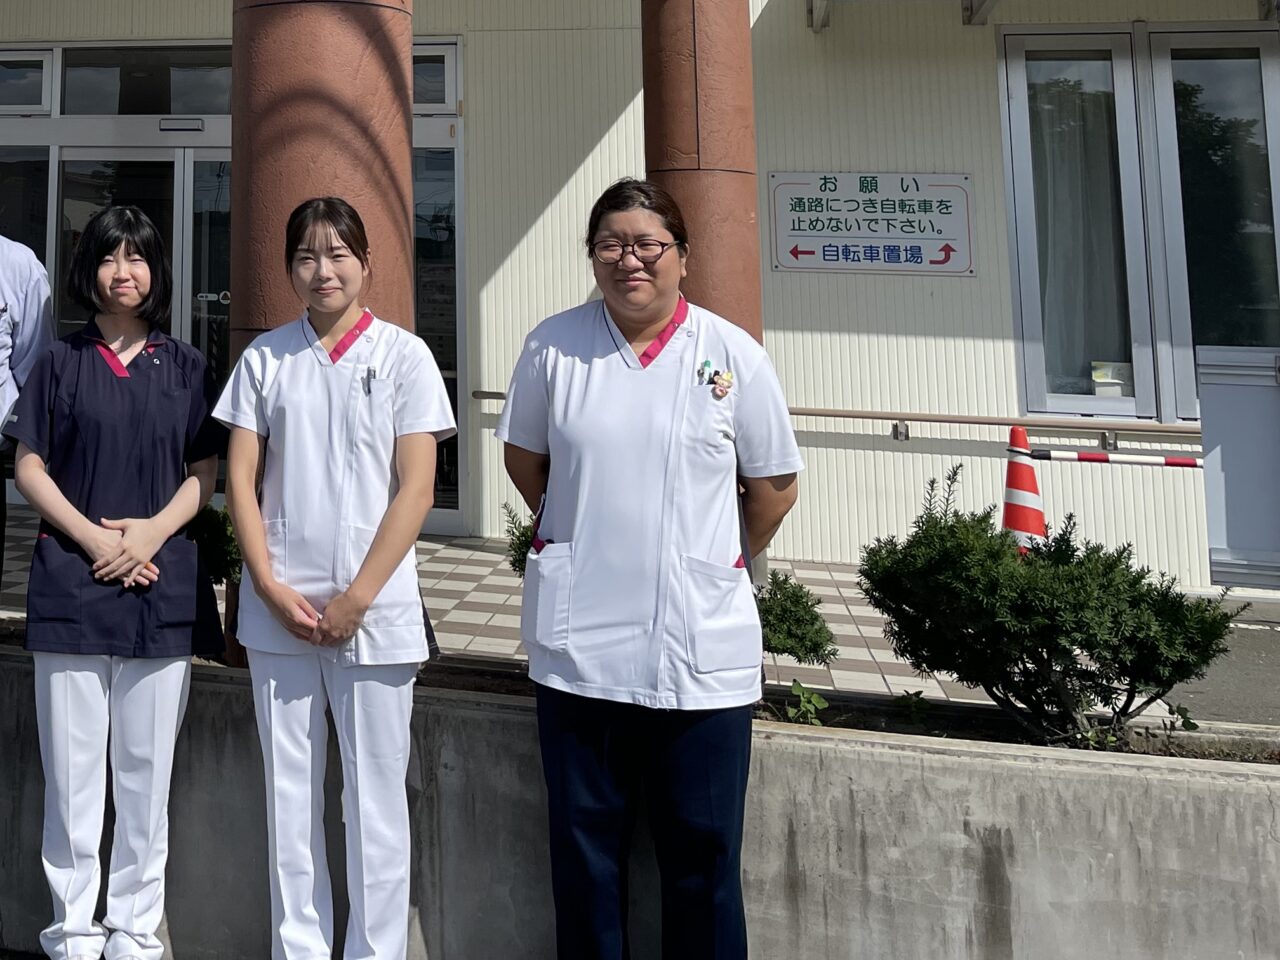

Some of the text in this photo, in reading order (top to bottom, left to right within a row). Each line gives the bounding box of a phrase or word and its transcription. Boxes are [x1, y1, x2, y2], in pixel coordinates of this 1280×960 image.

[819, 175, 920, 194] お願い
[789, 197, 953, 216] 通路につき自転車を
[790, 216, 943, 235] 止めないで下さい。
[822, 243, 923, 265] 自転車置場
